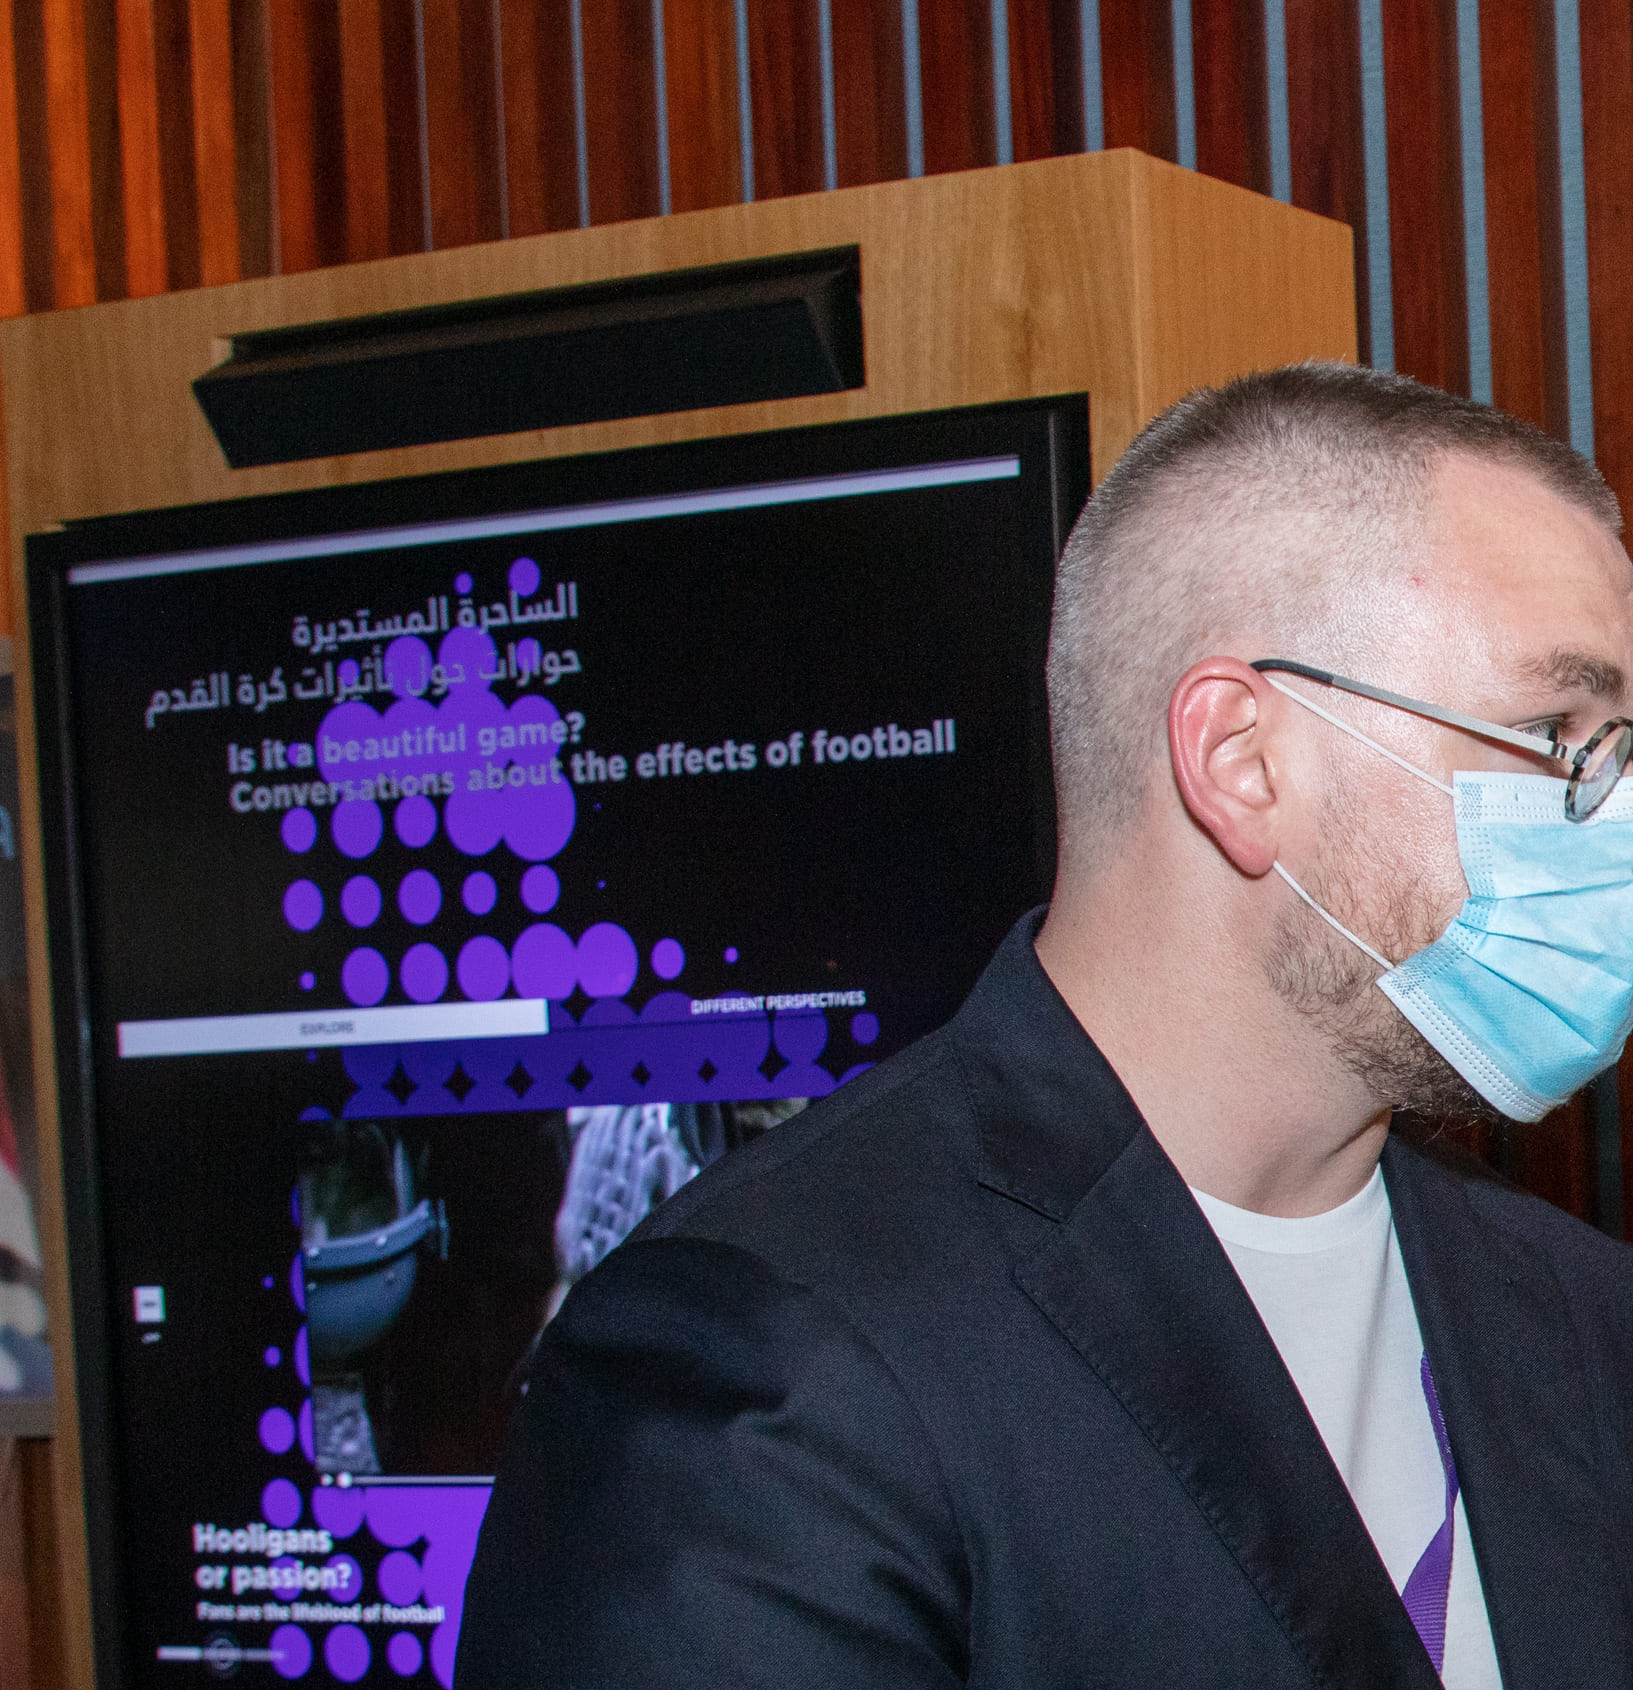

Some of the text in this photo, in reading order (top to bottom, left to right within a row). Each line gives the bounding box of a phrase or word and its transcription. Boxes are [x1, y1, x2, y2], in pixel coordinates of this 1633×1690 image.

[291, 582, 579, 654] الساحرة المستديرة
[145, 671, 231, 729] القدم
[236, 666, 288, 713] كرة
[227, 710, 587, 774] Is it a beautiful game?
[230, 717, 957, 813] Conversations about the effects of football
[691, 990, 867, 1016] DIFFERENT PERSPECTIVES
[192, 1522, 334, 1558] Hooligans
[195, 1560, 354, 1596] or passion?
[196, 1601, 235, 1622] Fans
[236, 1604, 263, 1622] are
[264, 1602, 290, 1622] the
[362, 1603, 381, 1623] of
[382, 1604, 446, 1625] football
